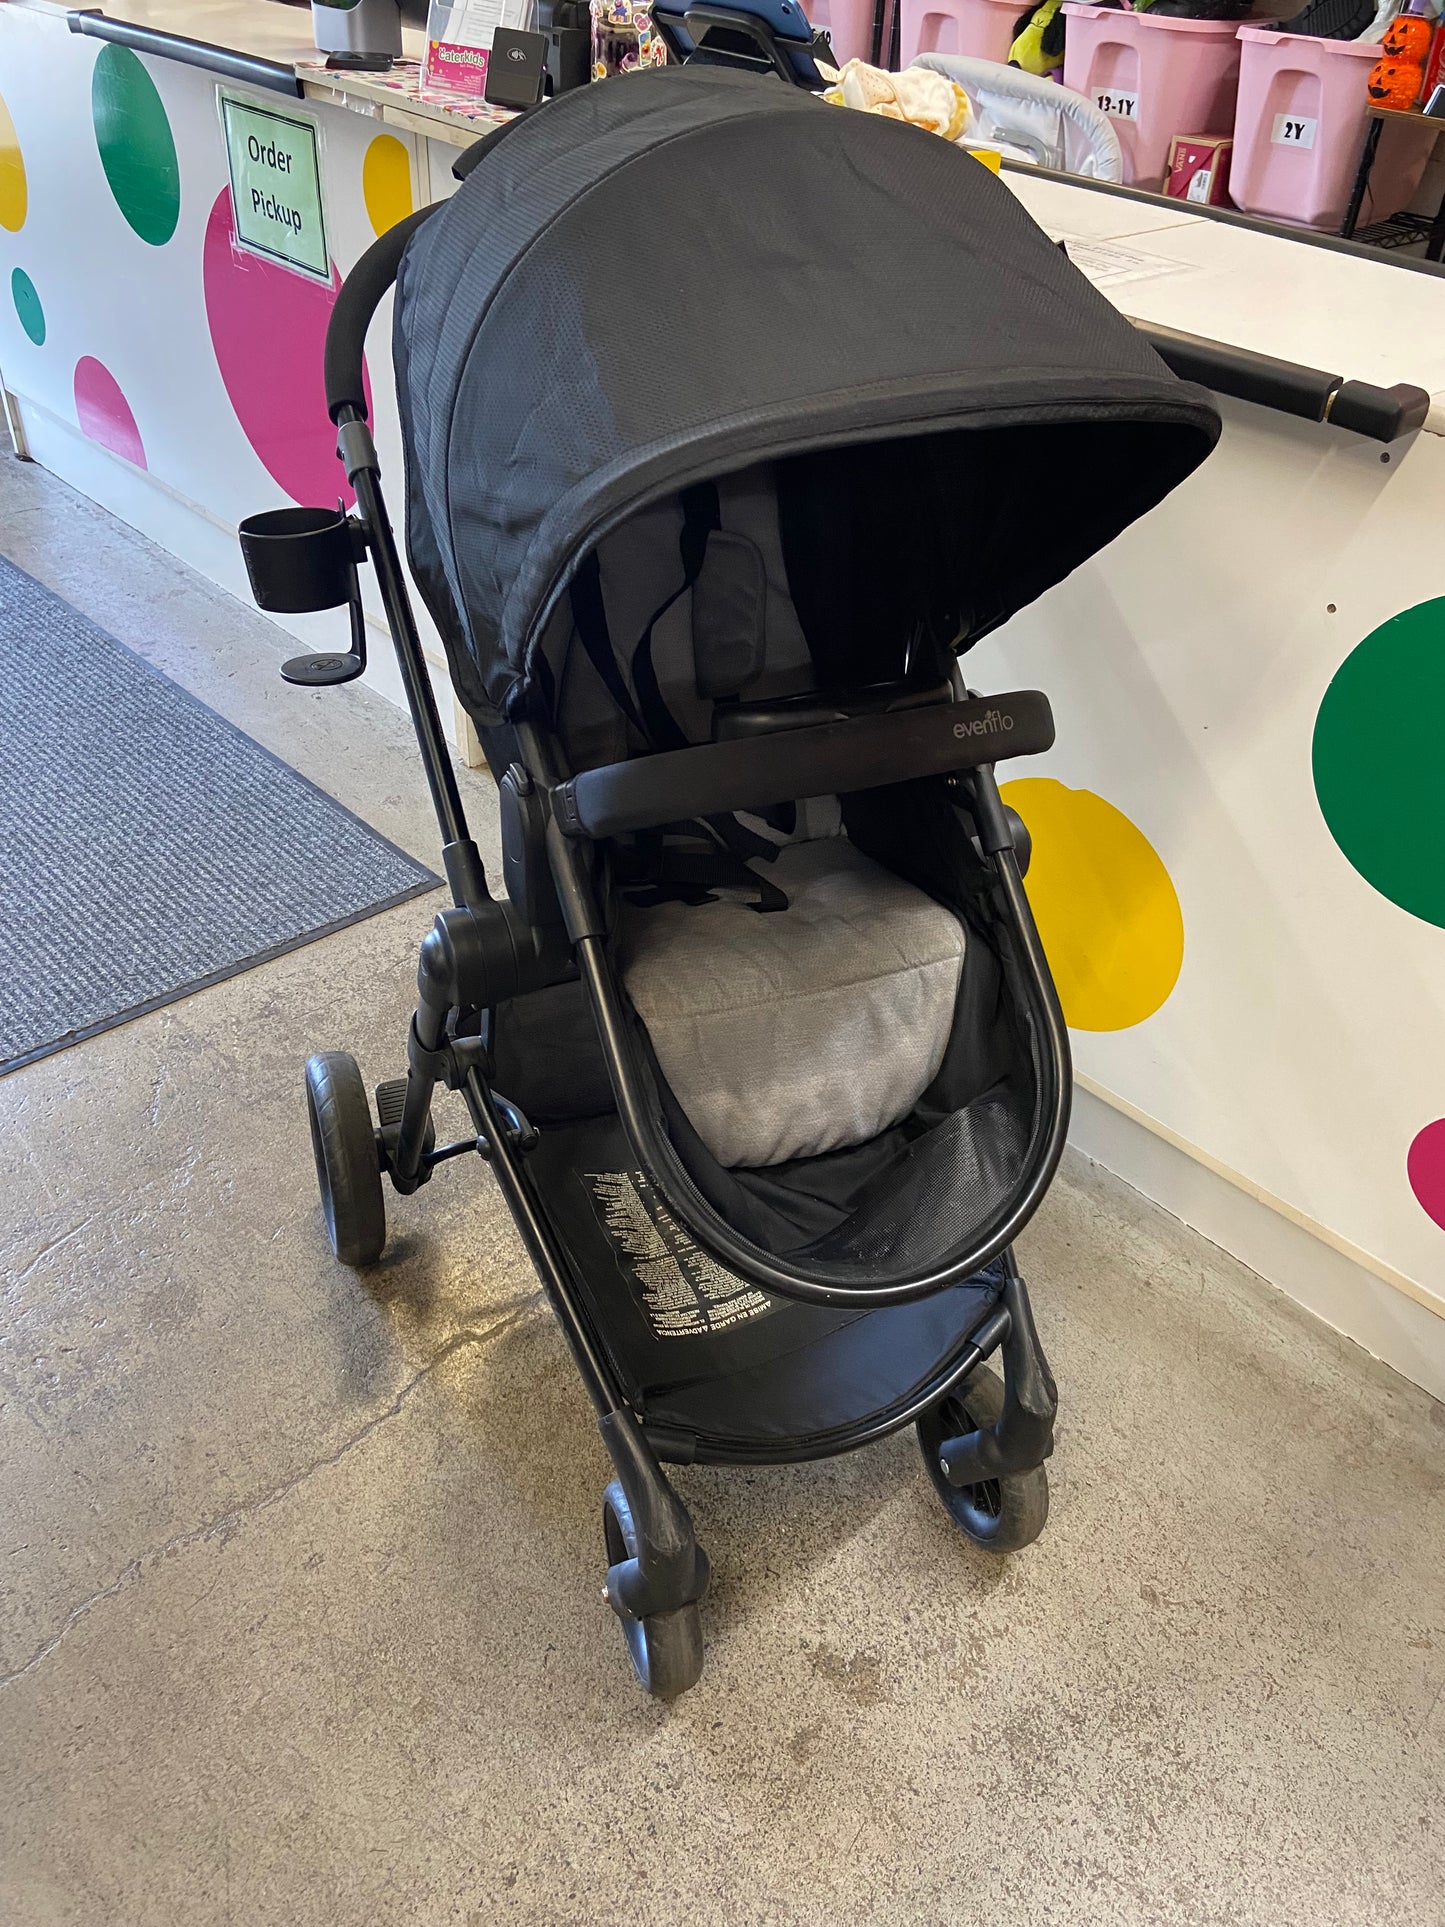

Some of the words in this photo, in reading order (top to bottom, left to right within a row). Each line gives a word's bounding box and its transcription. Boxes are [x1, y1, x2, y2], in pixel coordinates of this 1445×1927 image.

[1284, 122, 1306, 140] 2Y
[247, 135, 292, 174] Order
[1174, 147, 1187, 173] VANS
[251, 188, 302, 235] Pickup
[953, 710, 1014, 739] evenflo
[738, 1312, 748, 1321] EN
[750, 1304, 767, 1316] MISE
[656, 1325, 702, 1336] ADVERTENCIA
[710, 1315, 737, 1331] GARDE
